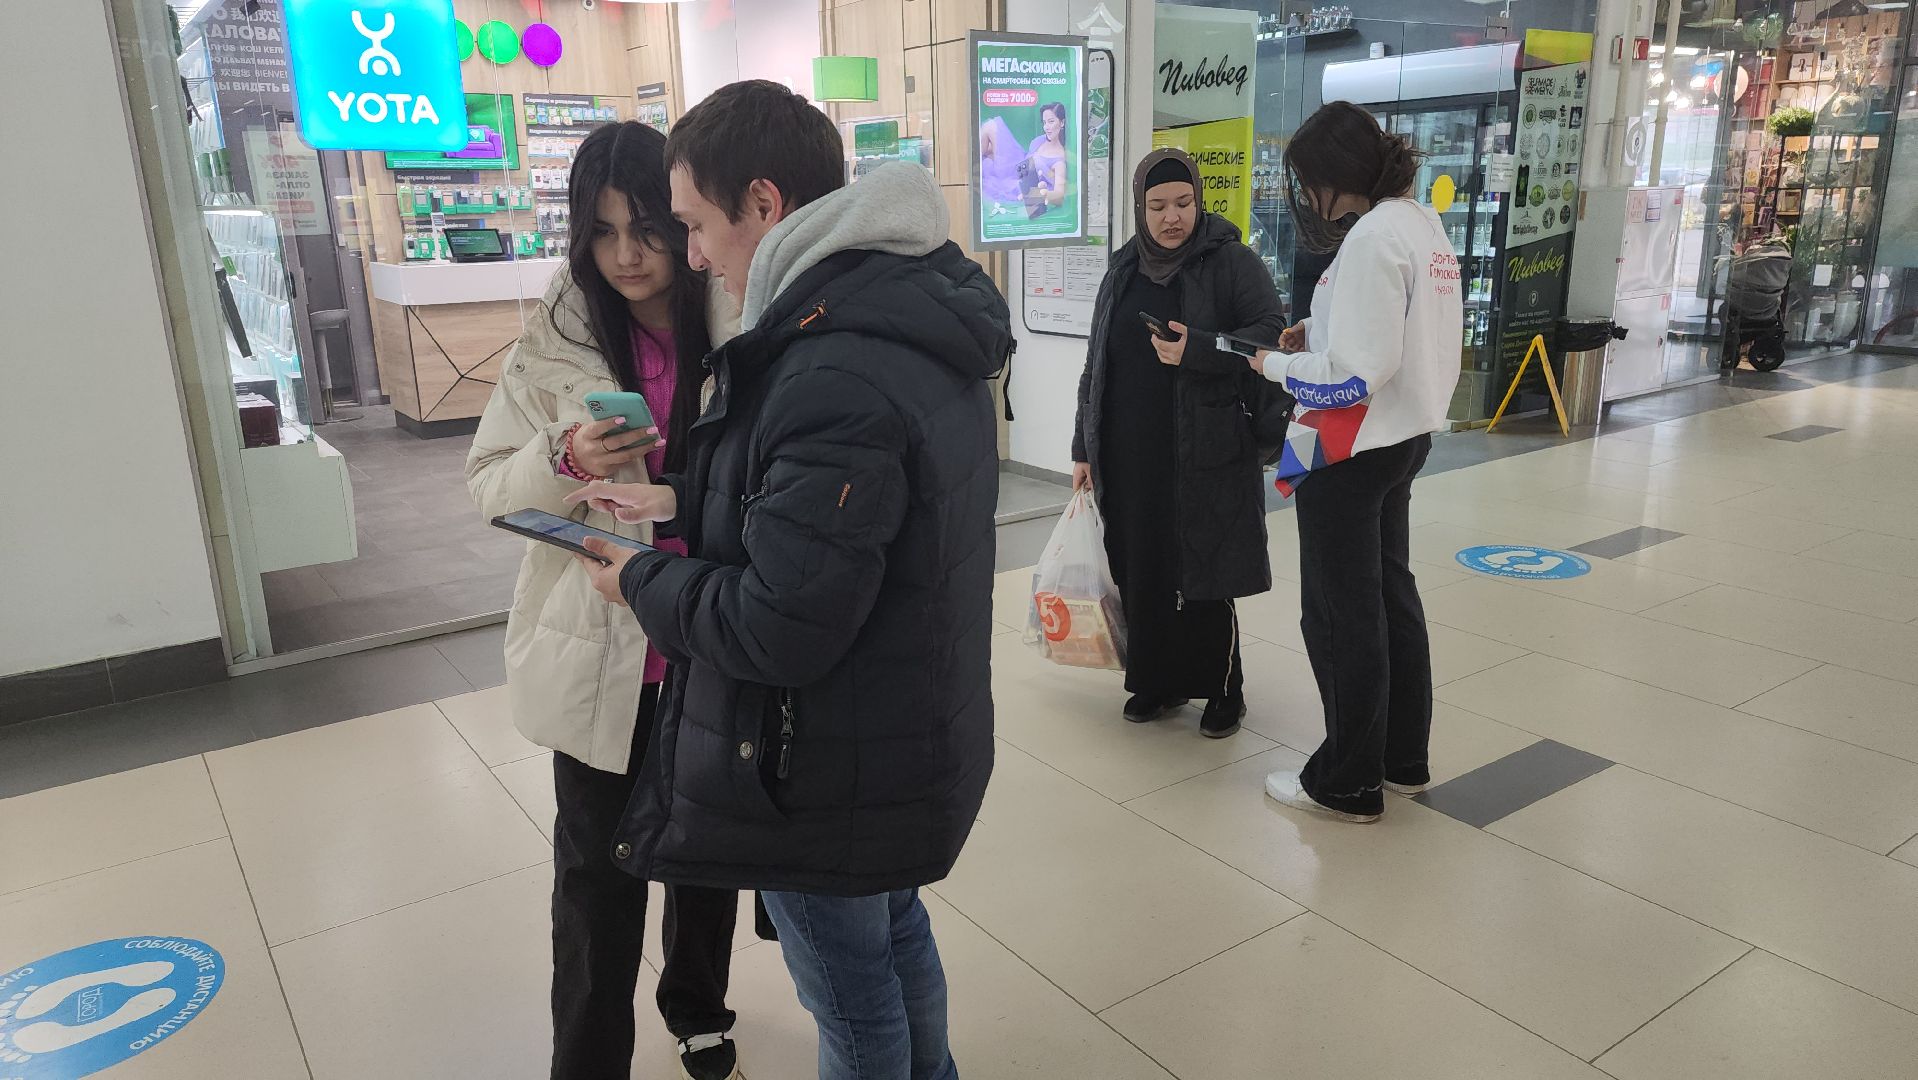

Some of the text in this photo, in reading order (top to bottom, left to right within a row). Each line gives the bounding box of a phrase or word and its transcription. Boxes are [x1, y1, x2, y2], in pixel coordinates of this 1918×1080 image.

[206, 24, 281, 41] АЛОВА
[981, 58, 1067, 75] МЕГАСКИДКИ
[232, 82, 280, 93] ВИДЕТЬ
[327, 91, 440, 125] YOTA
[1201, 175, 1240, 189] ТОВЫЕ
[1212, 200, 1228, 212] СО
[1332, 384, 1360, 403] МЫ
[1039, 593, 1062, 634] 5
[125, 939, 216, 1050] СОБЛЮДАЙТЕ ДИСТАНЦИЮ
